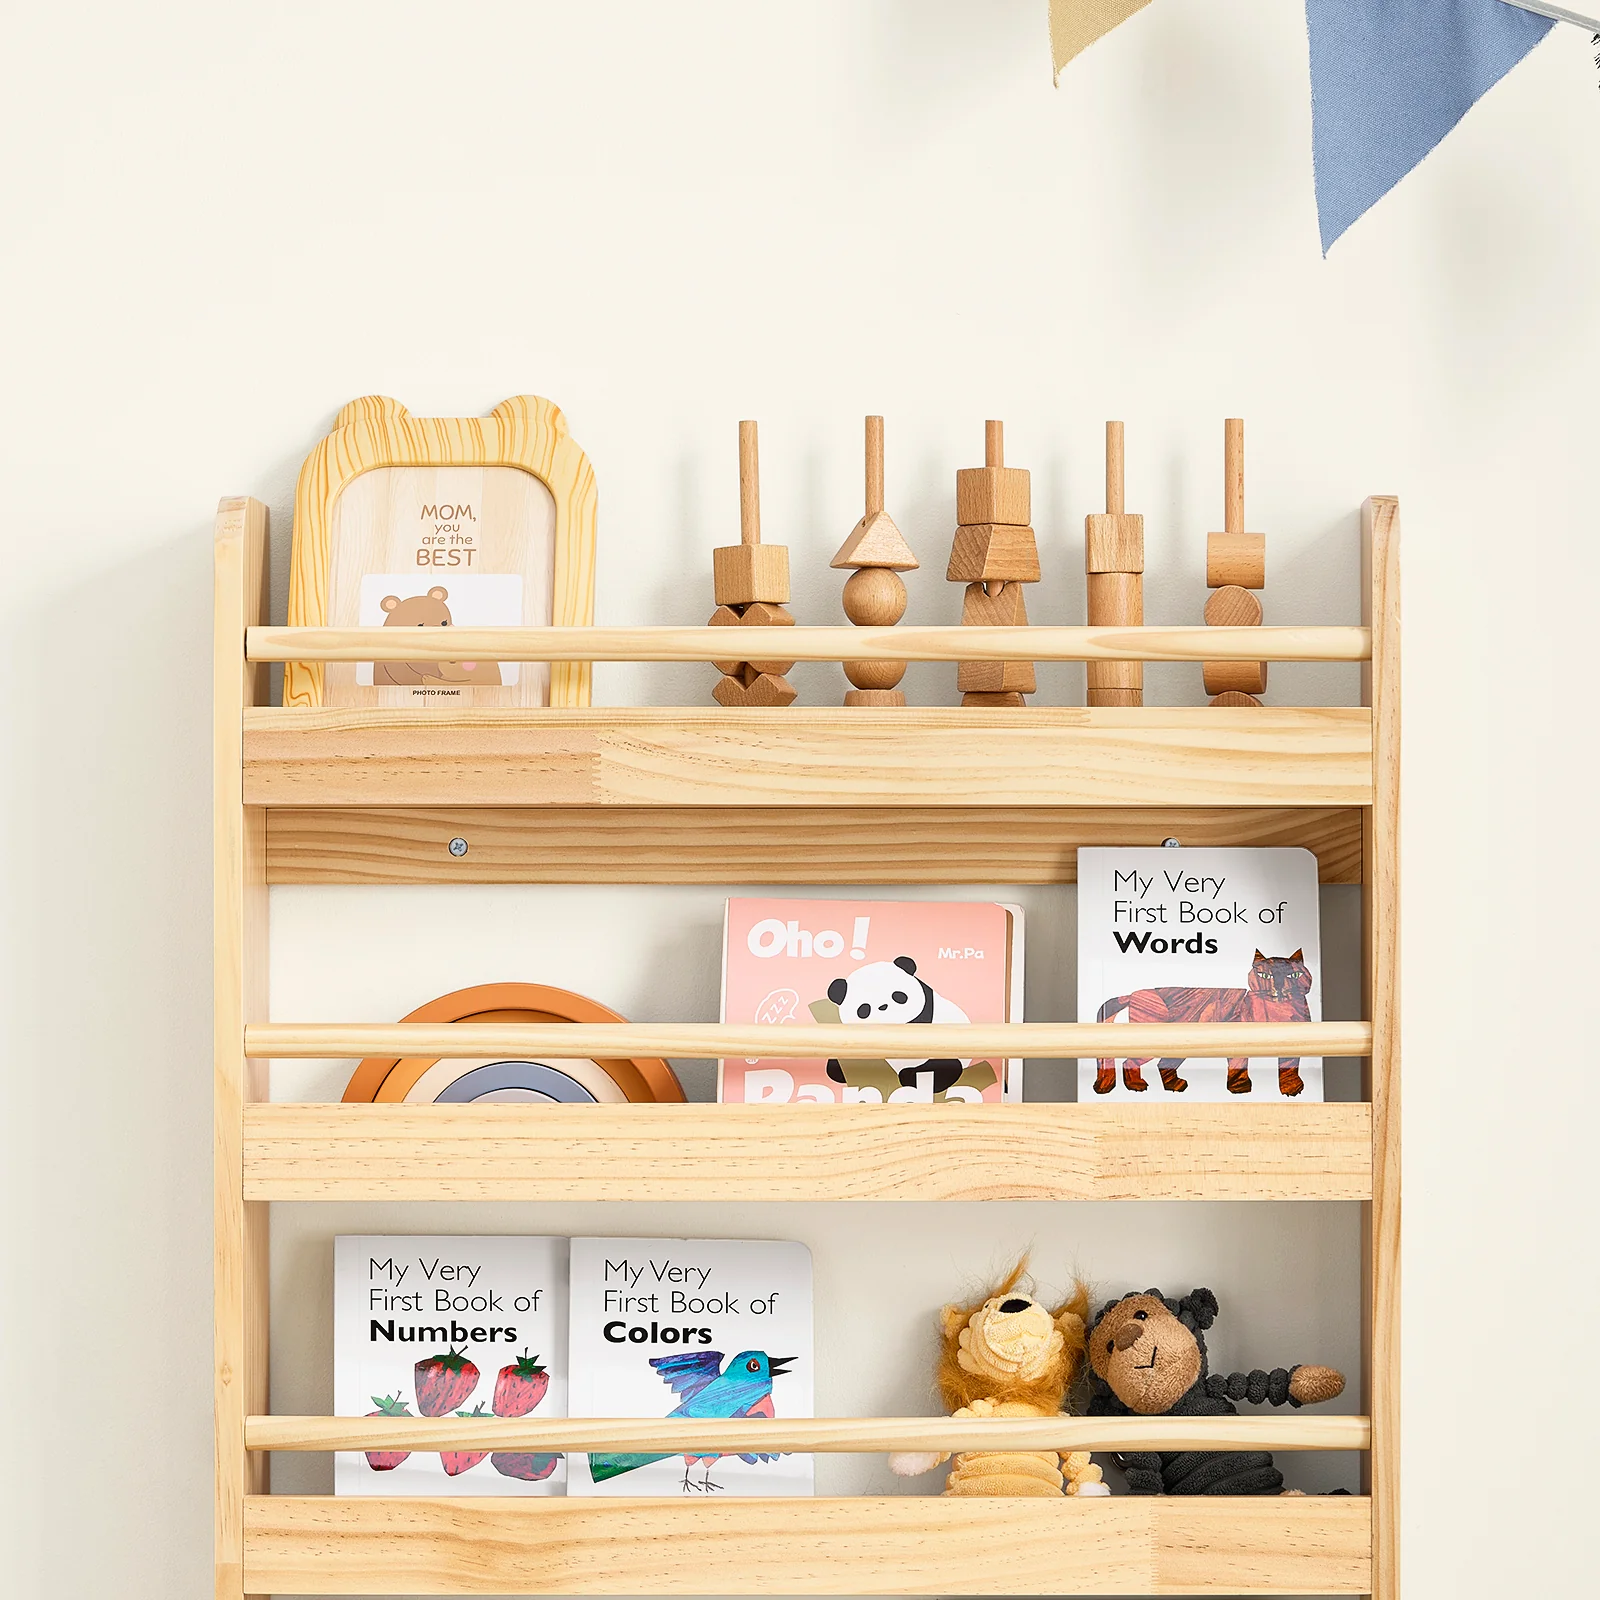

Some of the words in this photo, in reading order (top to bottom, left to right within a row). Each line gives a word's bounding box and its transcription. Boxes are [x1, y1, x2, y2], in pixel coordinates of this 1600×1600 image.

[420, 504, 477, 523] MOM,
[421, 535, 446, 545] are
[449, 532, 473, 545] the
[434, 523, 460, 536] you
[416, 548, 477, 567] BEST
[1114, 869, 1154, 899] My
[1163, 869, 1226, 899] Very
[1114, 900, 1168, 924] First
[1179, 900, 1249, 924] Book
[1258, 901, 1288, 924] of
[937, 946, 985, 960] Mr.Pa
[1112, 930, 1219, 955] Words
[369, 1257, 410, 1288] My
[418, 1257, 482, 1288] Very
[604, 1258, 645, 1289] My
[648, 1259, 712, 1290] Very
[369, 1288, 424, 1312] First
[435, 1288, 505, 1312] Book
[513, 1289, 544, 1313] of
[604, 1289, 660, 1314] First
[671, 1289, 740, 1314] Book
[749, 1292, 780, 1315] of
[369, 1319, 518, 1343] Numbers
[602, 1320, 713, 1345] Colors
